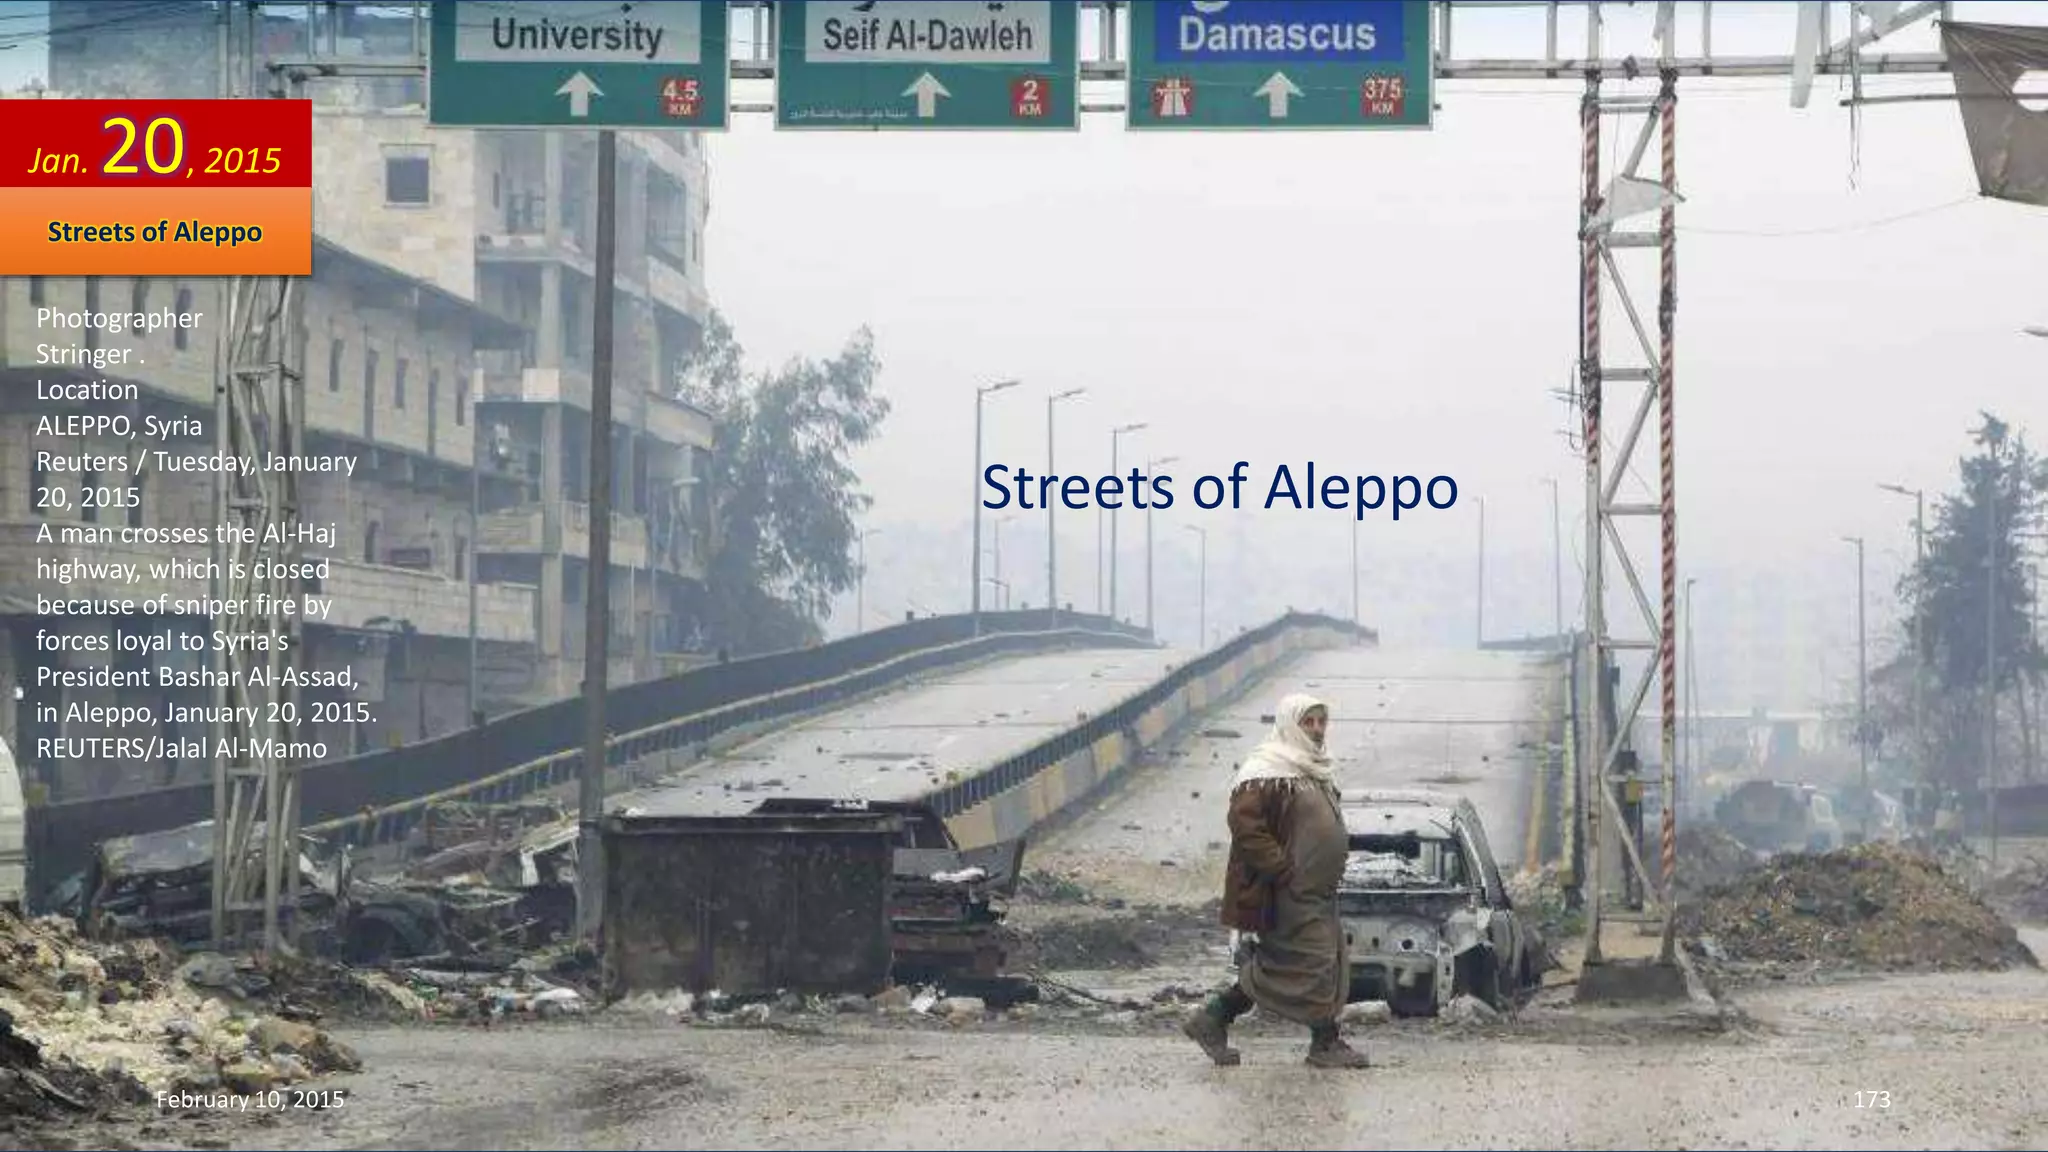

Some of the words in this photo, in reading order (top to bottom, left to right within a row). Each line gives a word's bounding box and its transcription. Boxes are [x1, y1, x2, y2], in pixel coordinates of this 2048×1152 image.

[491, 16, 664, 59] University
[823, 16, 880, 51] Seif
[886, 16, 1033, 51] Al-Dawleh
[1179, 15, 1376, 51] Damascus
[663, 79, 699, 102] 4.5
[1022, 80, 1040, 101] 2
[1363, 77, 1403, 100] 375
[668, 102, 692, 116] KM
[1017, 102, 1042, 116] KM
[1371, 101, 1395, 116] KM
